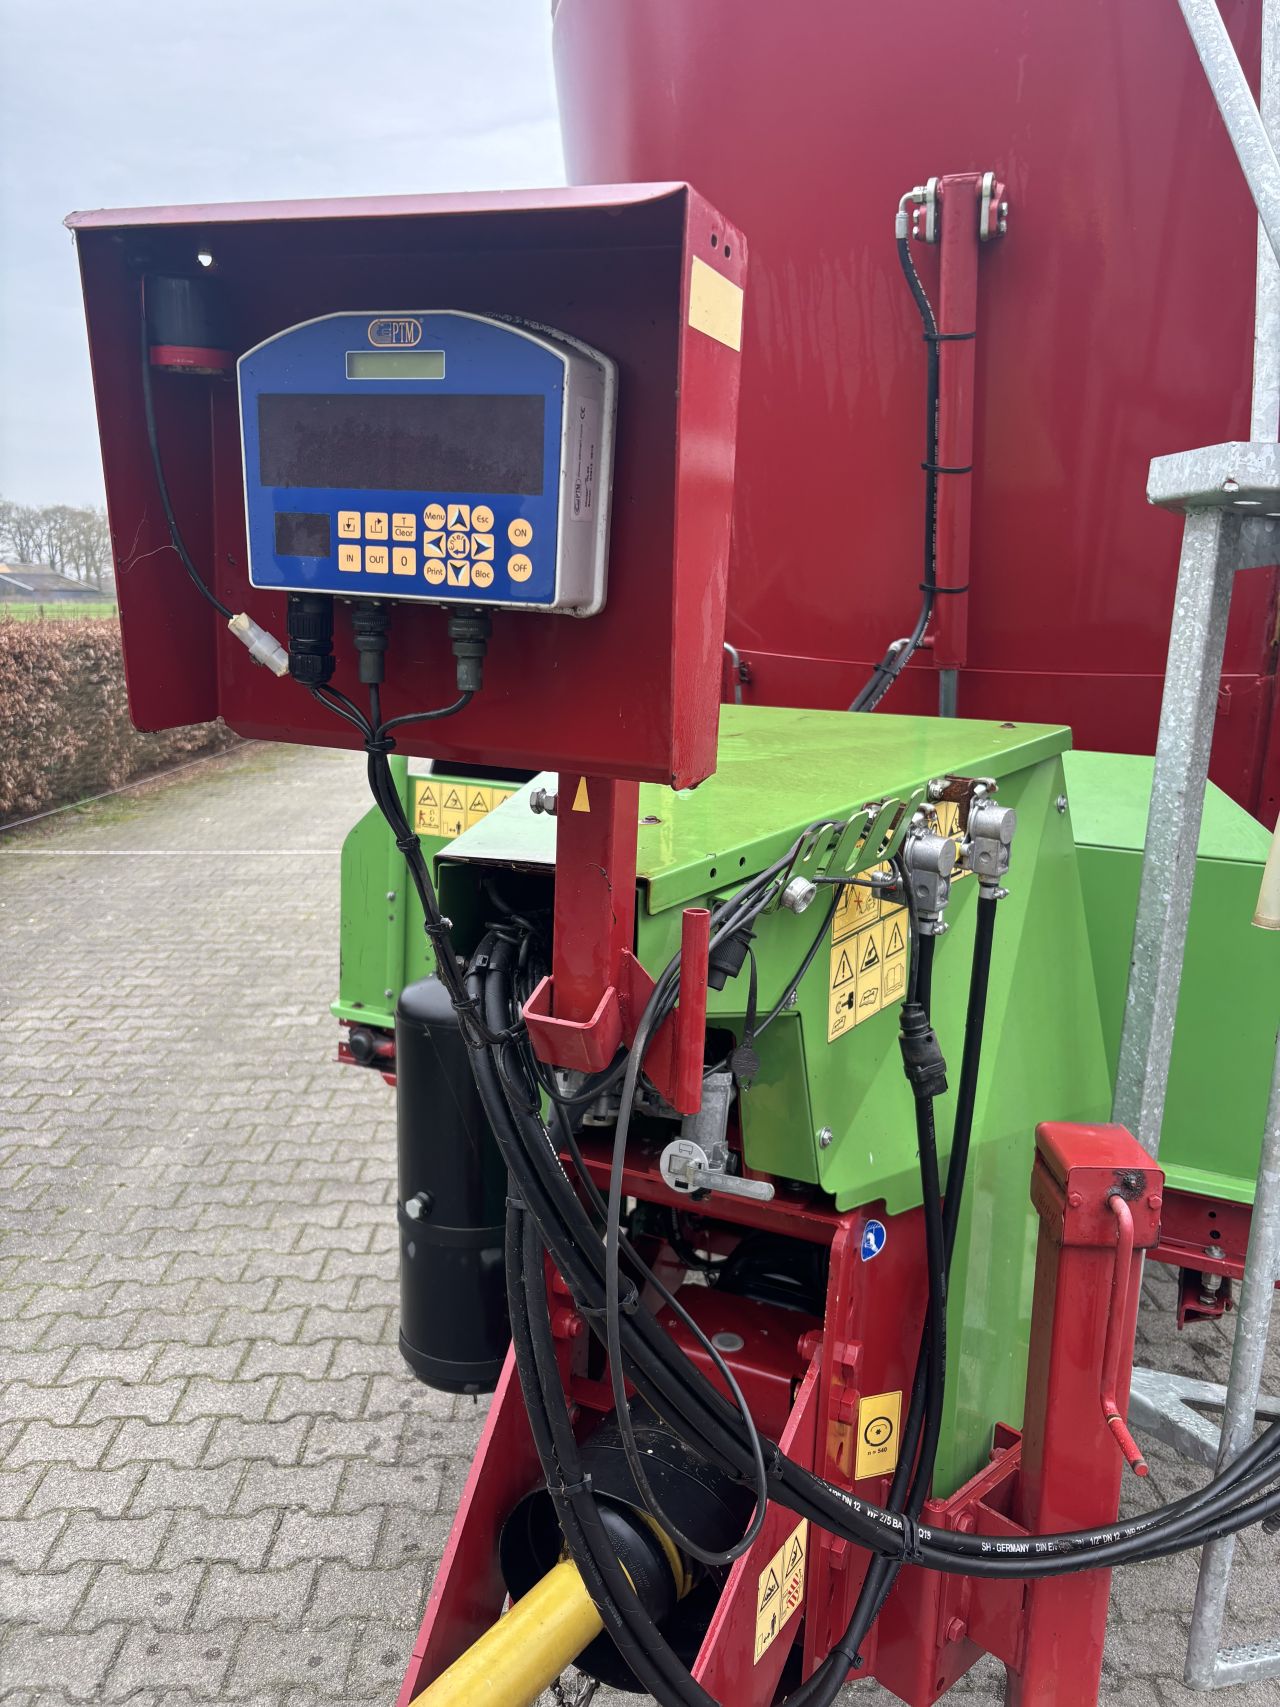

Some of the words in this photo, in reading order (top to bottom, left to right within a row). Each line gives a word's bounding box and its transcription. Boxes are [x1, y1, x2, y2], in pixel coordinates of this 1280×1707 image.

[392, 322, 414, 343] PTM
[401, 517, 407, 525] T
[424, 511, 446, 521] Menu
[476, 514, 490, 525] Esc
[394, 527, 414, 538] Clear
[514, 528, 528, 538] ON
[346, 553, 355, 563] IN
[368, 555, 385, 565] OUT
[426, 566, 444, 577] Print
[475, 569, 491, 579] Bloc
[853, 1500, 862, 1512] 12
[879, 1512, 892, 1526] 275
[981, 1541, 992, 1551] SH
[996, 1543, 1030, 1553] GERMANY
[1035, 1542, 1048, 1552] DIN
[1102, 1533, 1113, 1543] DN
[1113, 1531, 1121, 1543] 12
